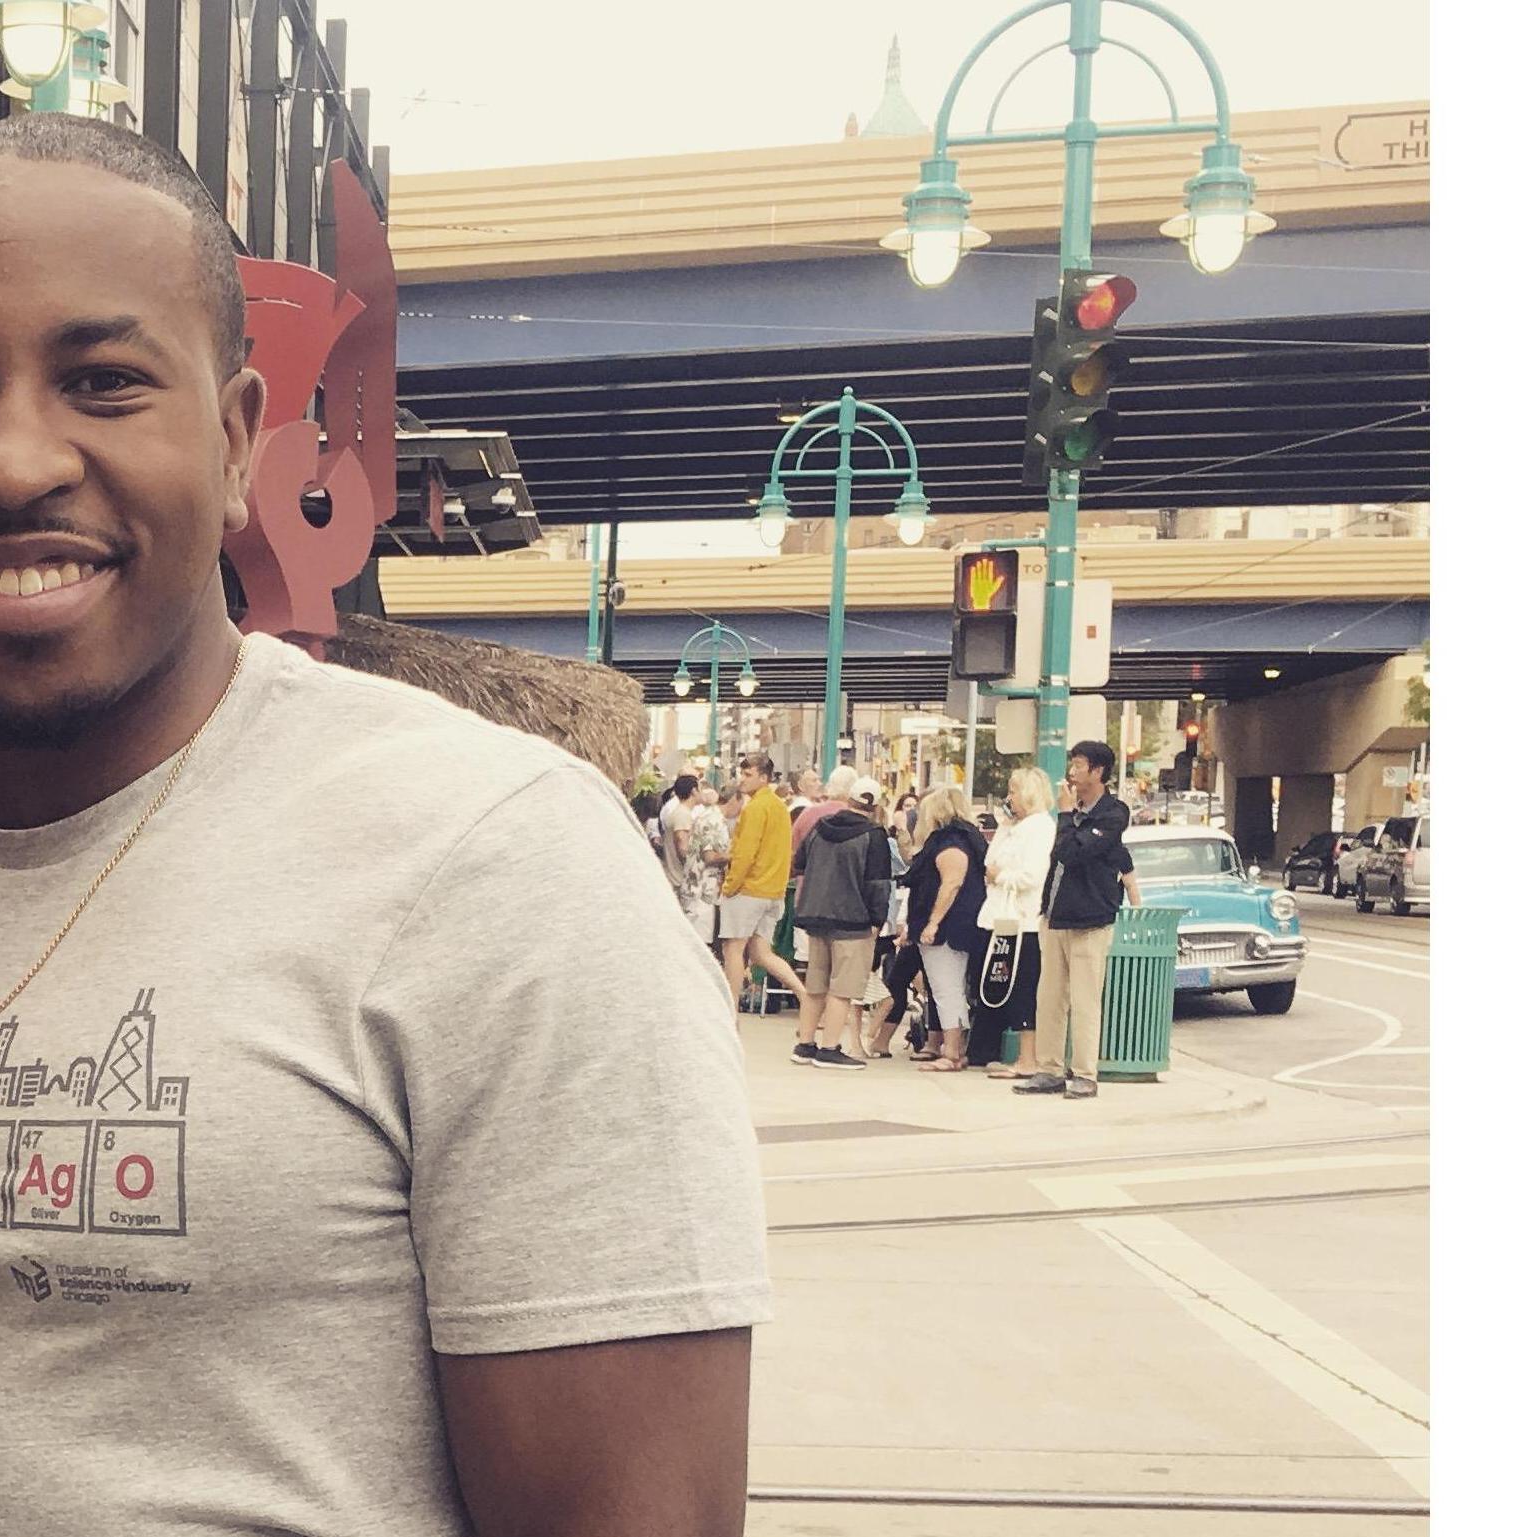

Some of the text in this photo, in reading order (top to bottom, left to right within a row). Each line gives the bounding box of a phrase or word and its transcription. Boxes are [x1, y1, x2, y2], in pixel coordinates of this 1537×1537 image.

[21, 1130, 43, 1149] 47
[103, 1131, 115, 1150] 8
[17, 1153, 77, 1209] Ag
[116, 1154, 155, 1200] O
[109, 1211, 161, 1227] Oxygen
[56, 1264, 129, 1278] museum of
